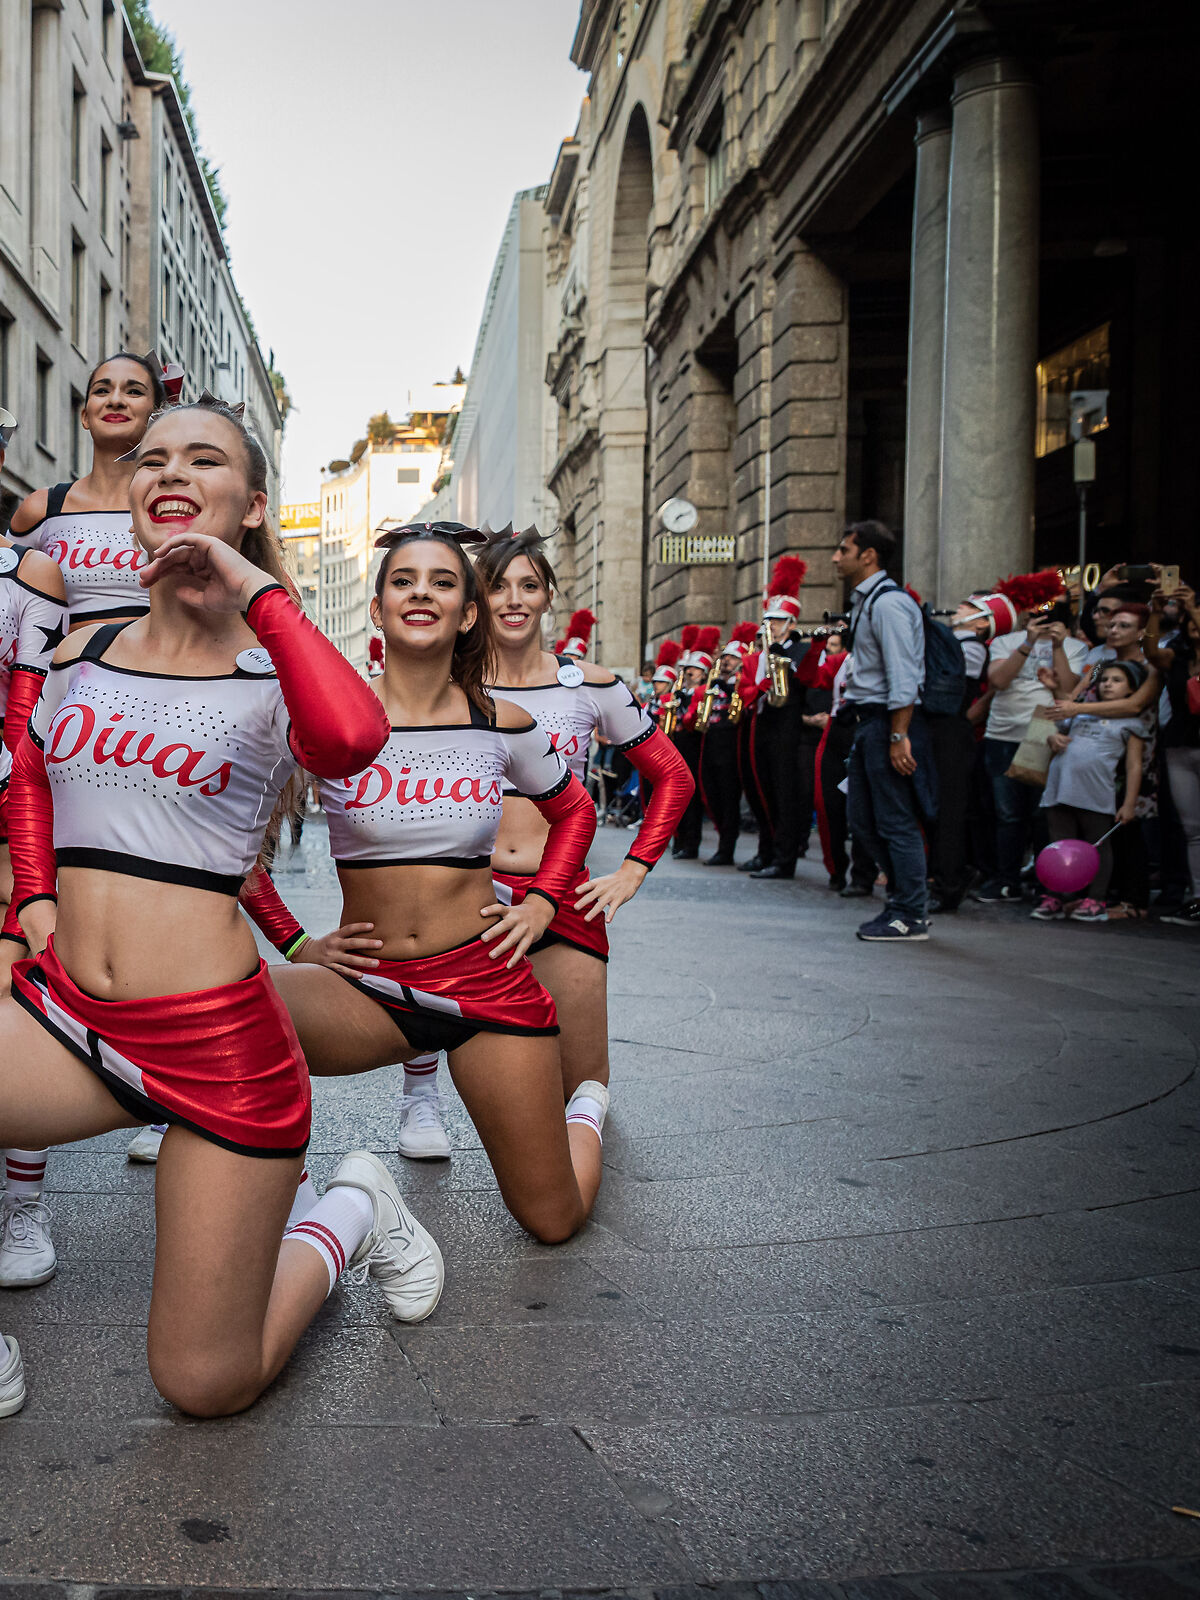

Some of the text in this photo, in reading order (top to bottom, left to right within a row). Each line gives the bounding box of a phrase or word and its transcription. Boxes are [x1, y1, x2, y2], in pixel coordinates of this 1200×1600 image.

[46, 540, 148, 571] Diva
[45, 703, 232, 796] Divas
[344, 763, 501, 810] Divas
